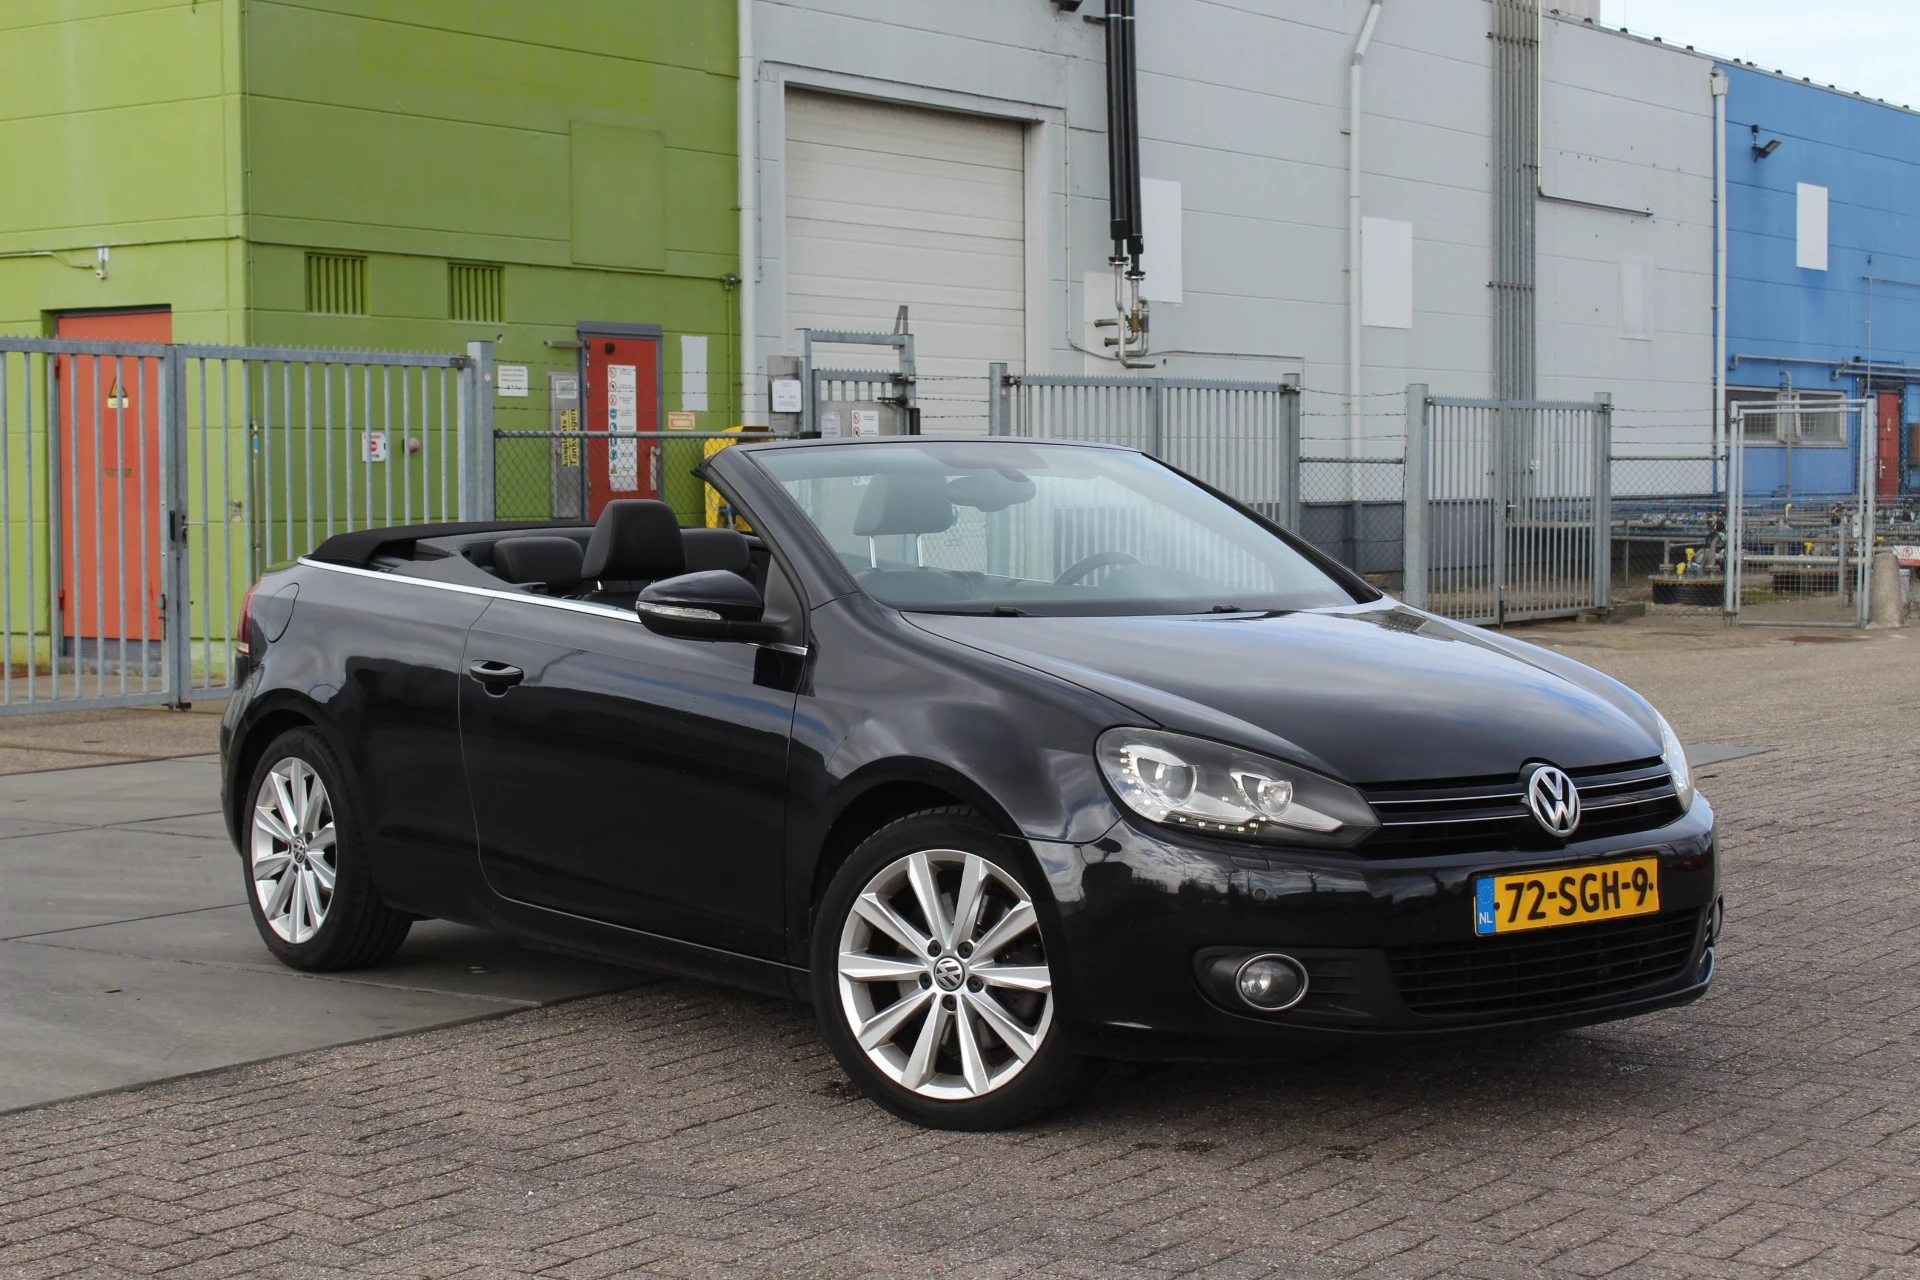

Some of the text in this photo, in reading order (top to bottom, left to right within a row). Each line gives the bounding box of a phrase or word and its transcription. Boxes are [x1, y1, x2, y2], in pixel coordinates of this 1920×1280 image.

[1529, 766, 1581, 837] VW
[1479, 911, 1493, 925] NL
[1505, 867, 1649, 923] 72-SGH-9
